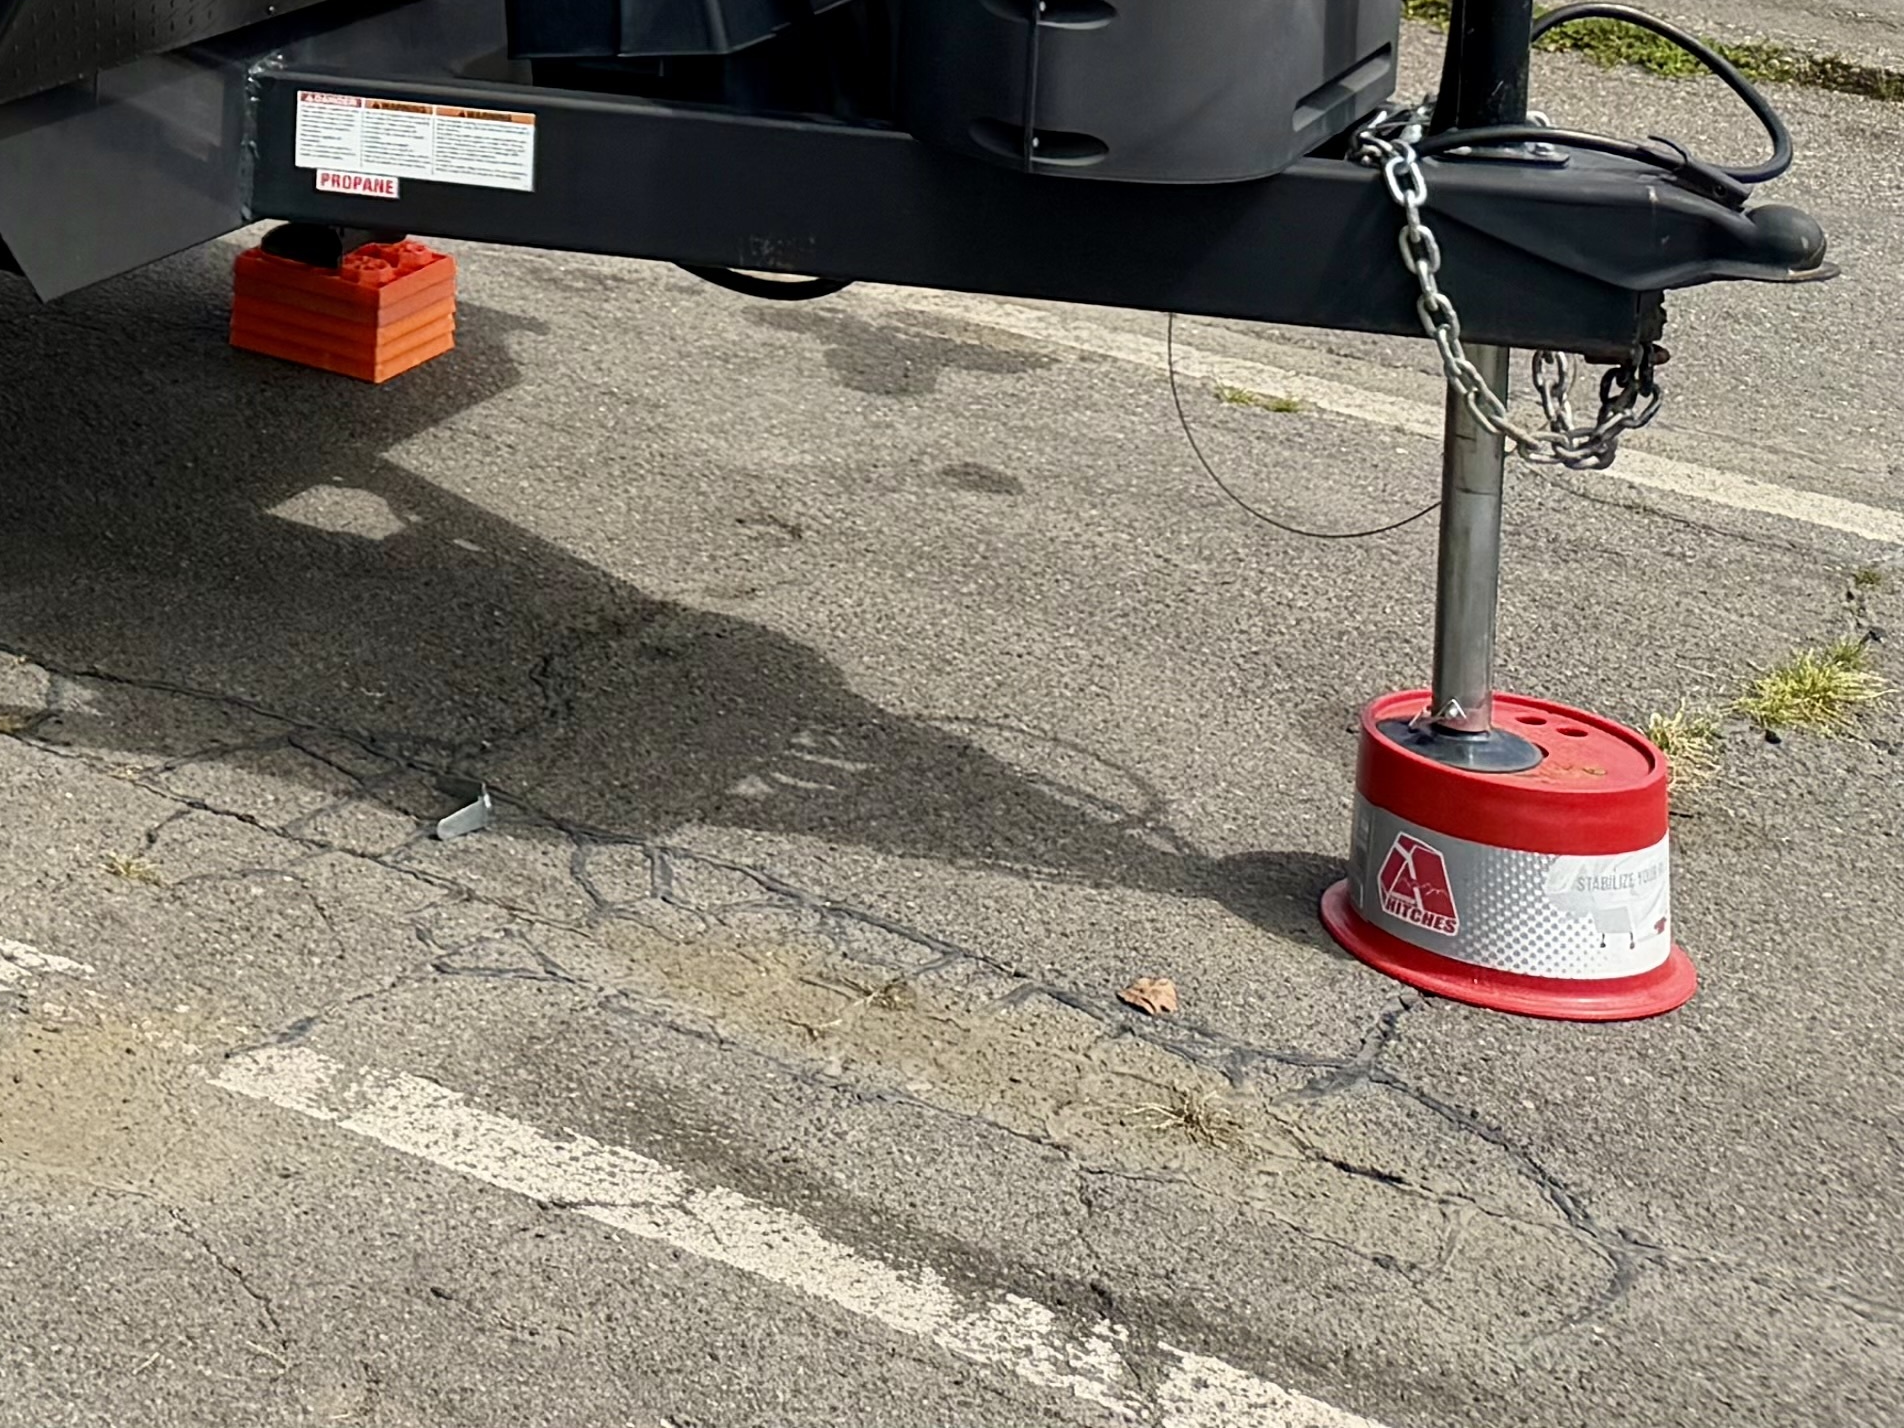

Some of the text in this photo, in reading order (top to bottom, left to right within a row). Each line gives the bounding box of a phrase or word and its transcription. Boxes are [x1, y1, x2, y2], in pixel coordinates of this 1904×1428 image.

[320, 172, 395, 195] PROPANE
[1576, 872, 1635, 892] STABILIZE
[1385, 897, 1457, 934] HITCHES
